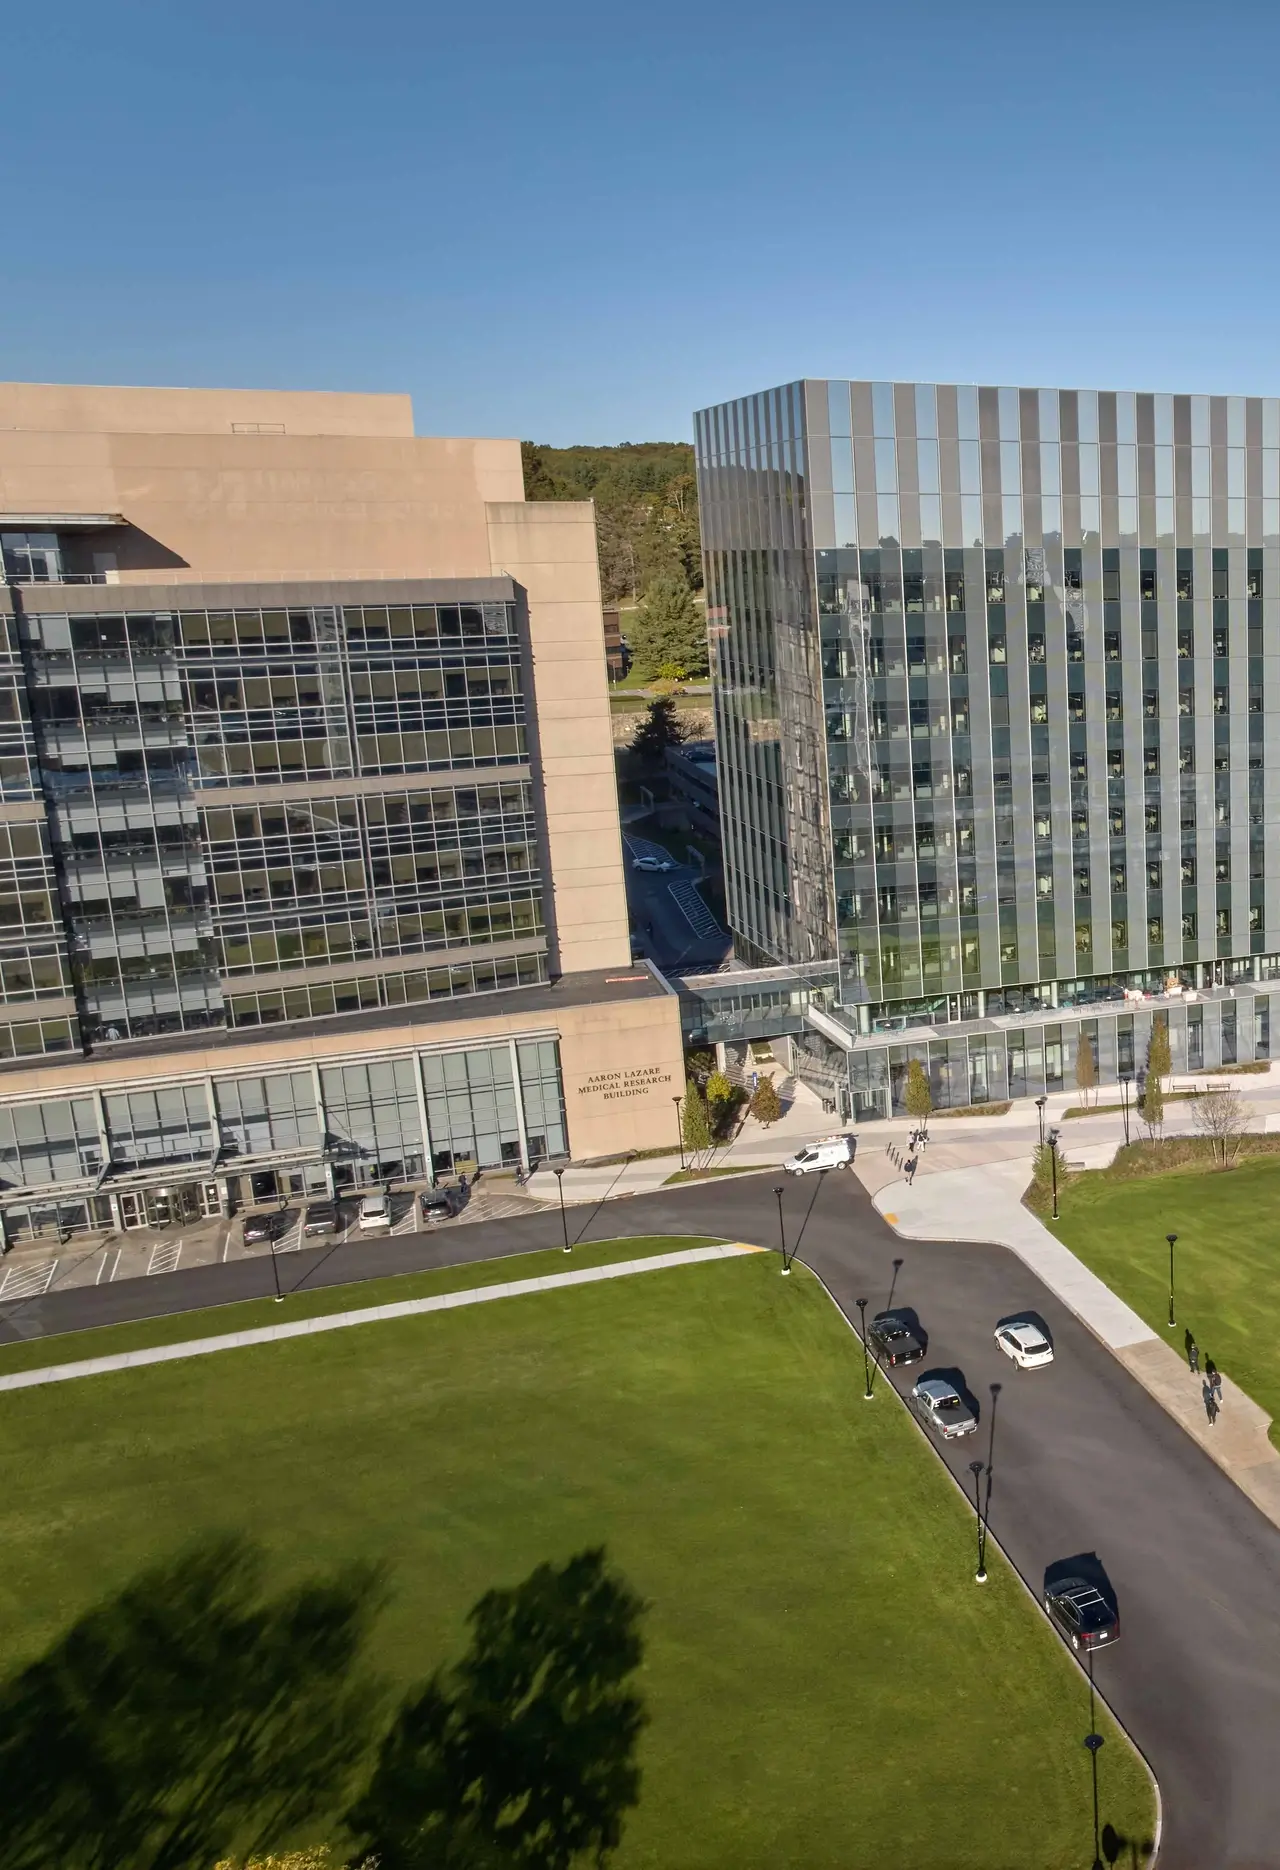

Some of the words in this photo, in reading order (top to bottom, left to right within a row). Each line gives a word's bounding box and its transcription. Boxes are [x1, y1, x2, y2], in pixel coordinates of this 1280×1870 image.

[588, 1072, 621, 1083] AARON
[624, 1067, 661, 1079] LAZARE
[578, 1082, 621, 1094] MEDICAL
[624, 1074, 672, 1088] RESEARCH
[603, 1087, 649, 1100] BUILDING
